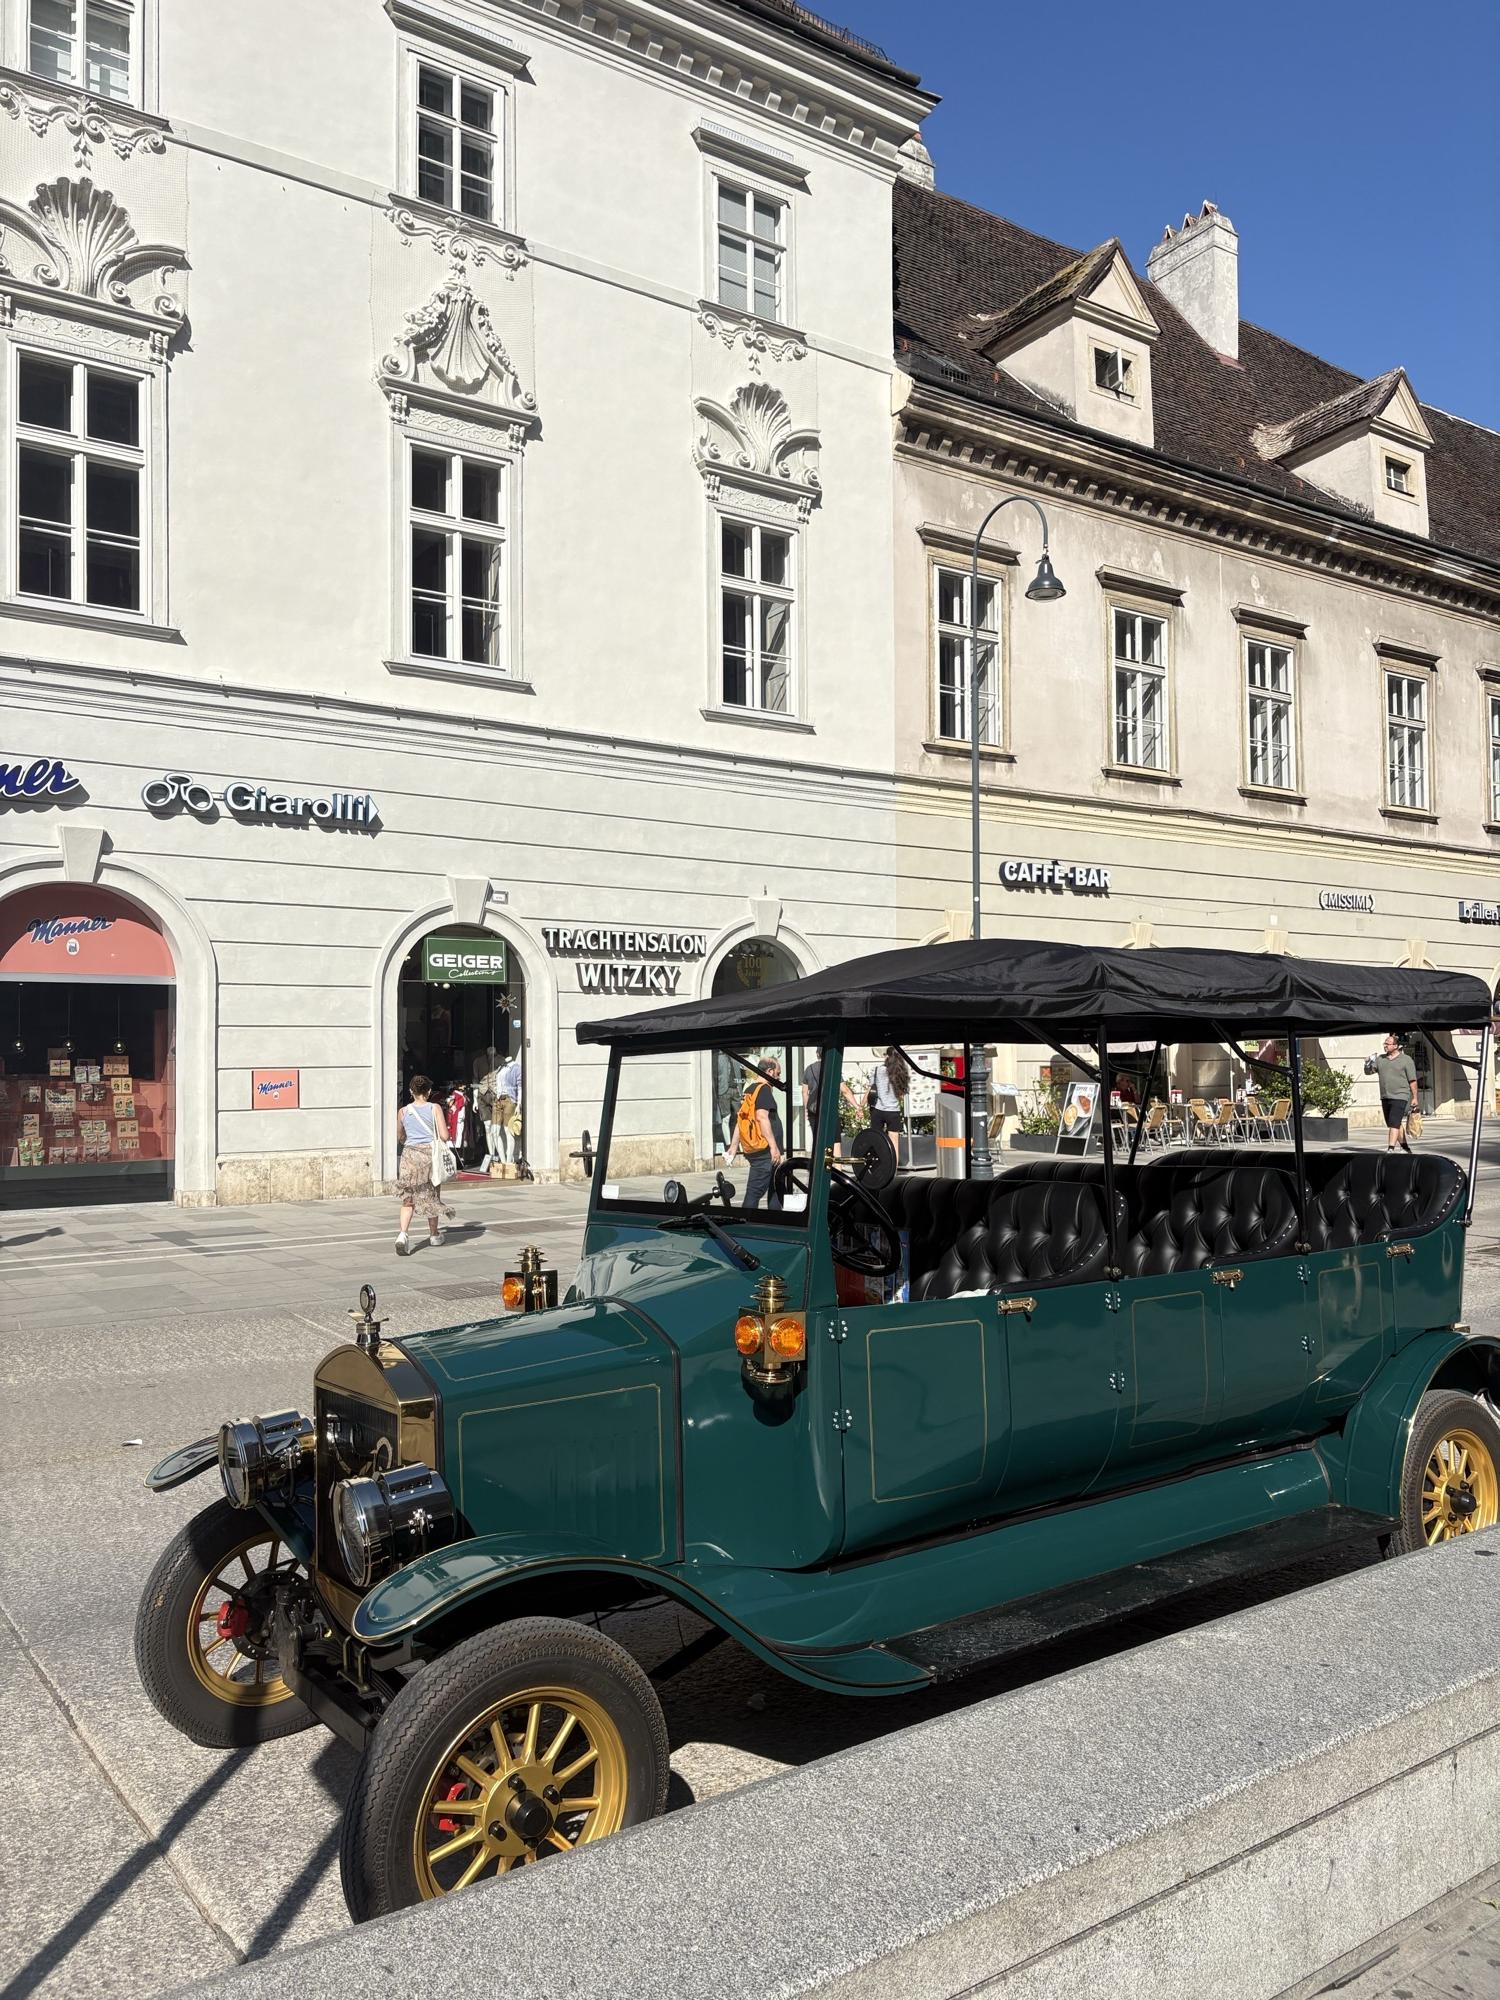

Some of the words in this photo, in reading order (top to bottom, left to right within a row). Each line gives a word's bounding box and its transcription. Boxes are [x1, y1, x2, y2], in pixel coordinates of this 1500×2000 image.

[224, 781, 364, 822] Giarolli
[1459, 901, 1500, 921] brillen
[27, 915, 112, 945] Manner
[545, 928, 706, 955] TRACHTENSALON
[429, 953, 503, 969] GEIGER
[579, 963, 682, 989] WITZKY
[257, 1081, 294, 1095] Manner
